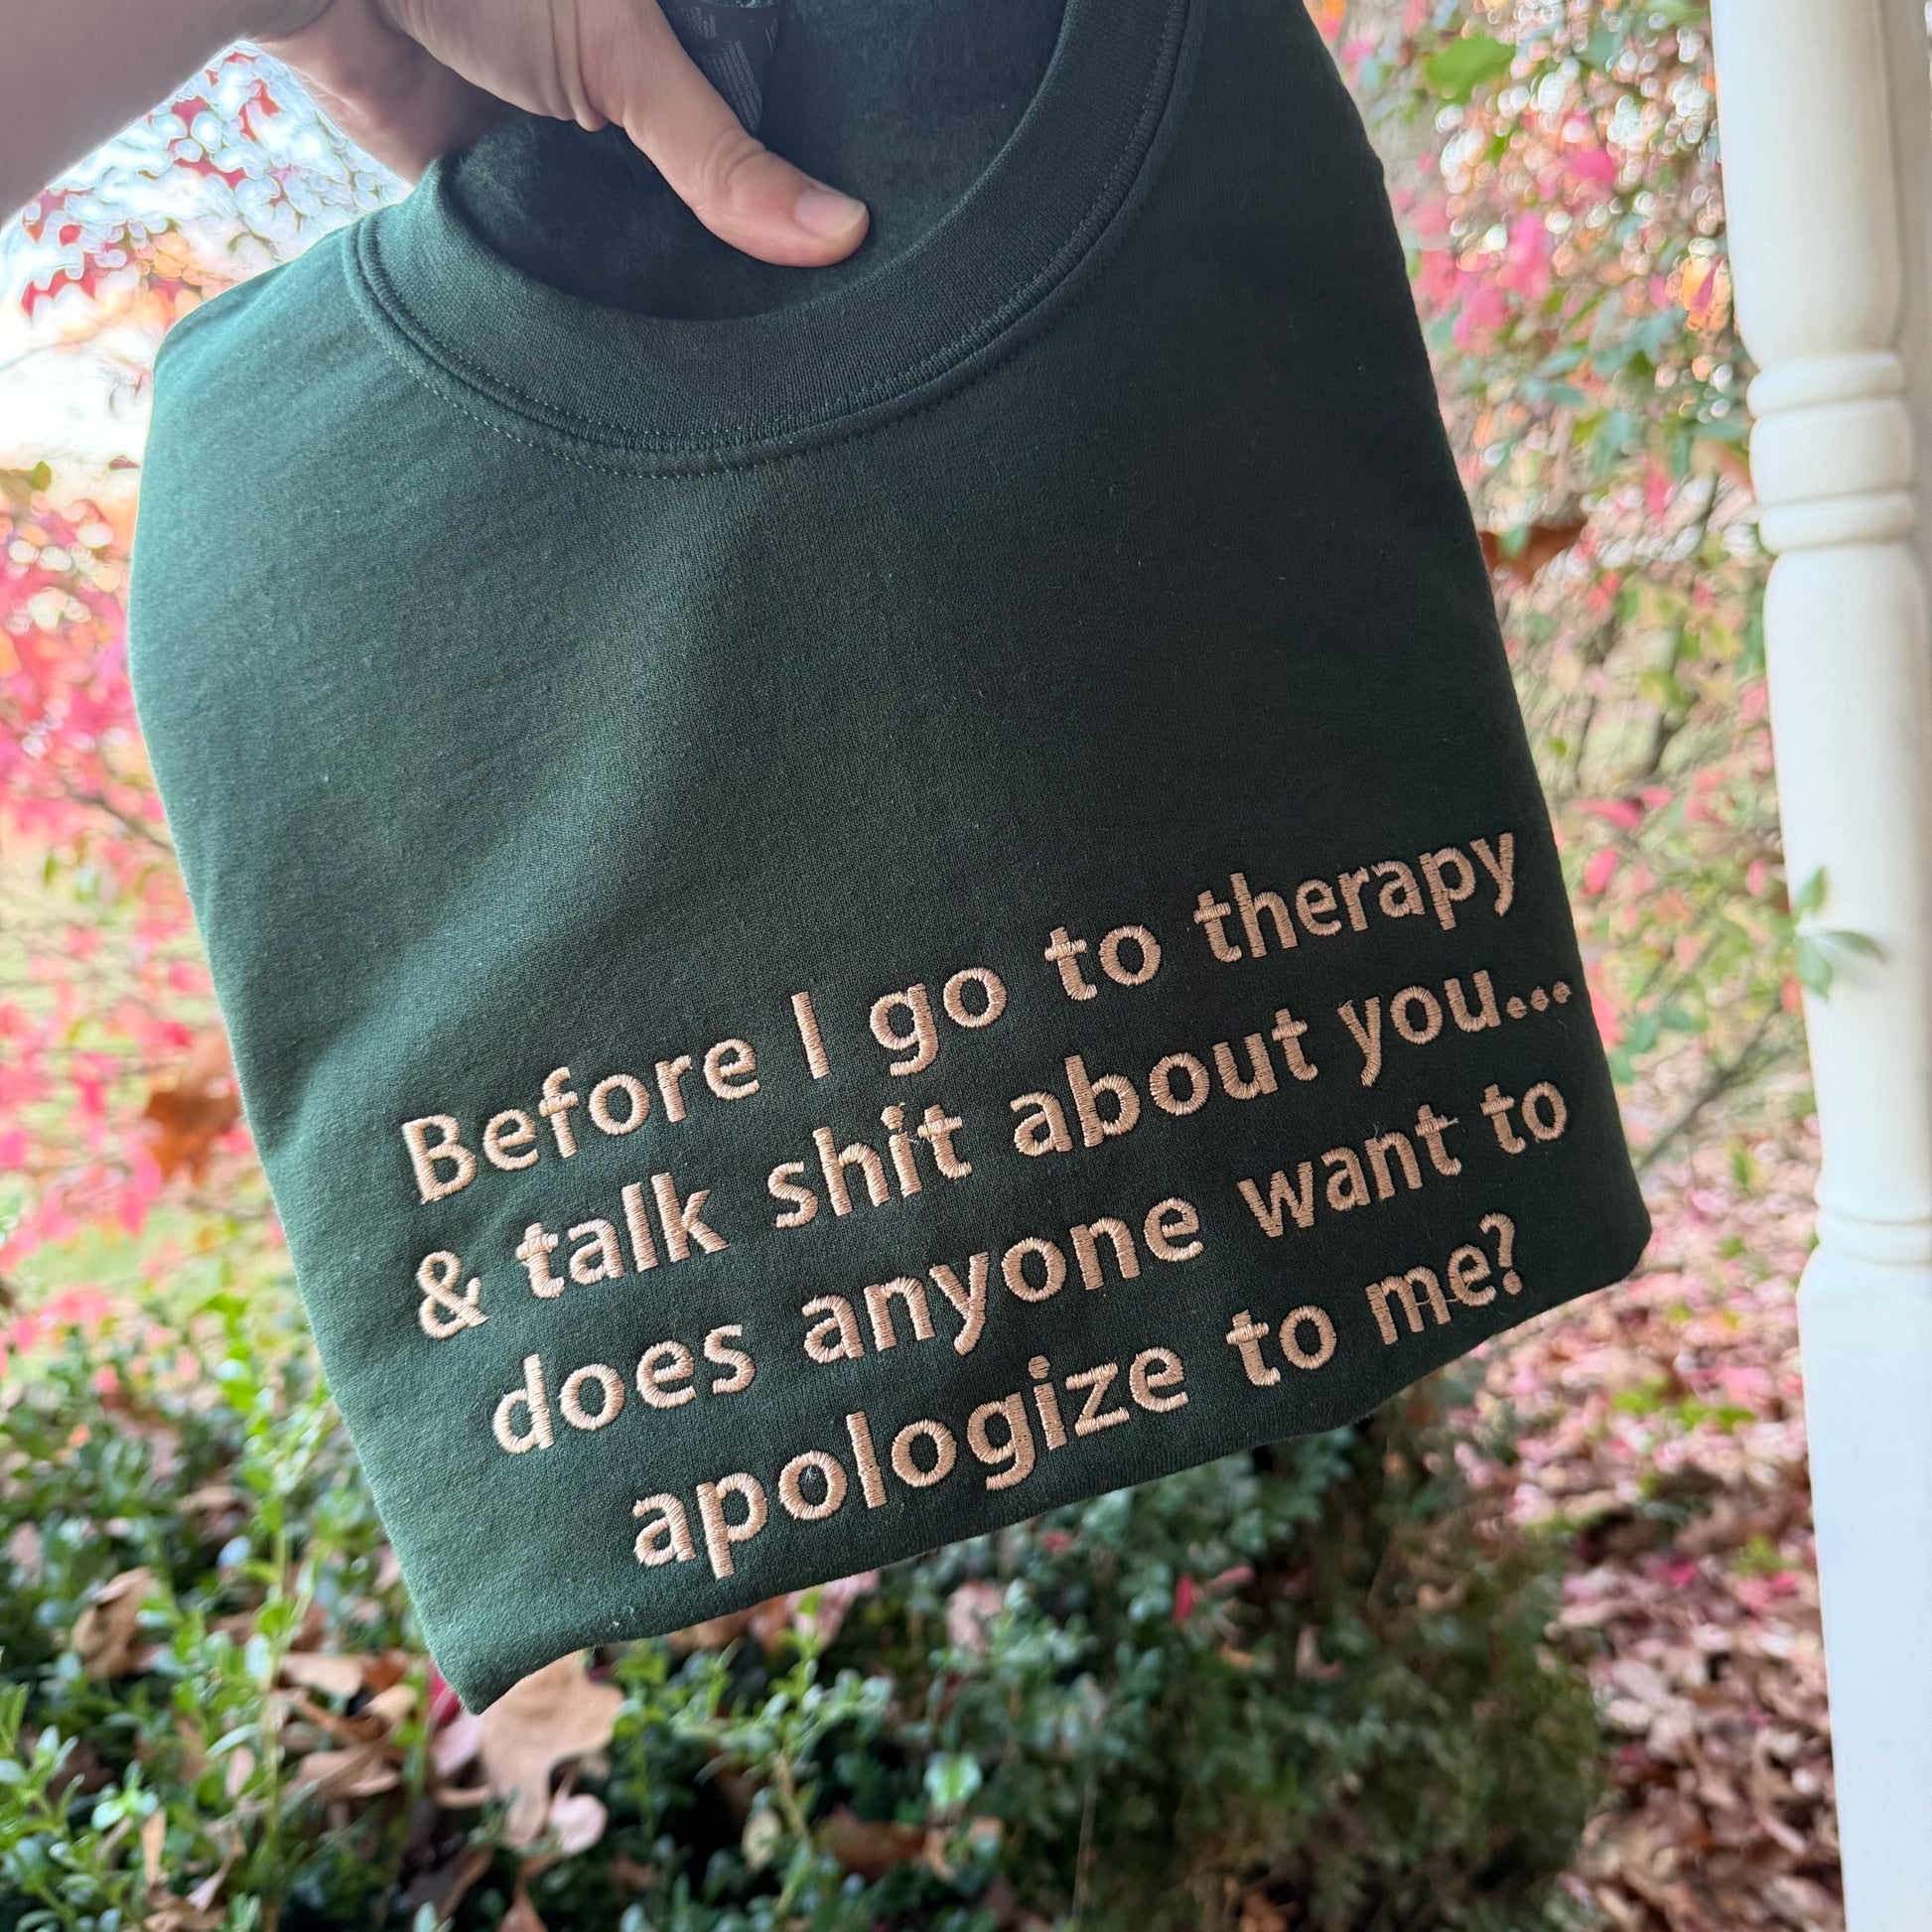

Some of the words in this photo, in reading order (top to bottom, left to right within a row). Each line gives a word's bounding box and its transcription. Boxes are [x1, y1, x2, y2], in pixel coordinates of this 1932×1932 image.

[401, 1036, 762, 1204] Before
[791, 990, 831, 1080] I
[869, 966, 1009, 1078] go
[1042, 924, 1163, 1003] to
[1193, 832, 1516, 964] therapy
[416, 1249, 487, 1338] &
[516, 1172, 730, 1299] talk
[766, 1103, 972, 1230] shit
[1010, 1008, 1319, 1159] about
[1336, 969, 1573, 1087] you...
[491, 1320, 756, 1454] does
[801, 1195, 1205, 1365] anyone
[1236, 1103, 1462, 1239] want
[1479, 1080, 1568, 1156] to
[632, 1345, 1189, 1579] apologize
[1225, 1305, 1338, 1387] to
[1364, 1212, 1524, 1346] me?
